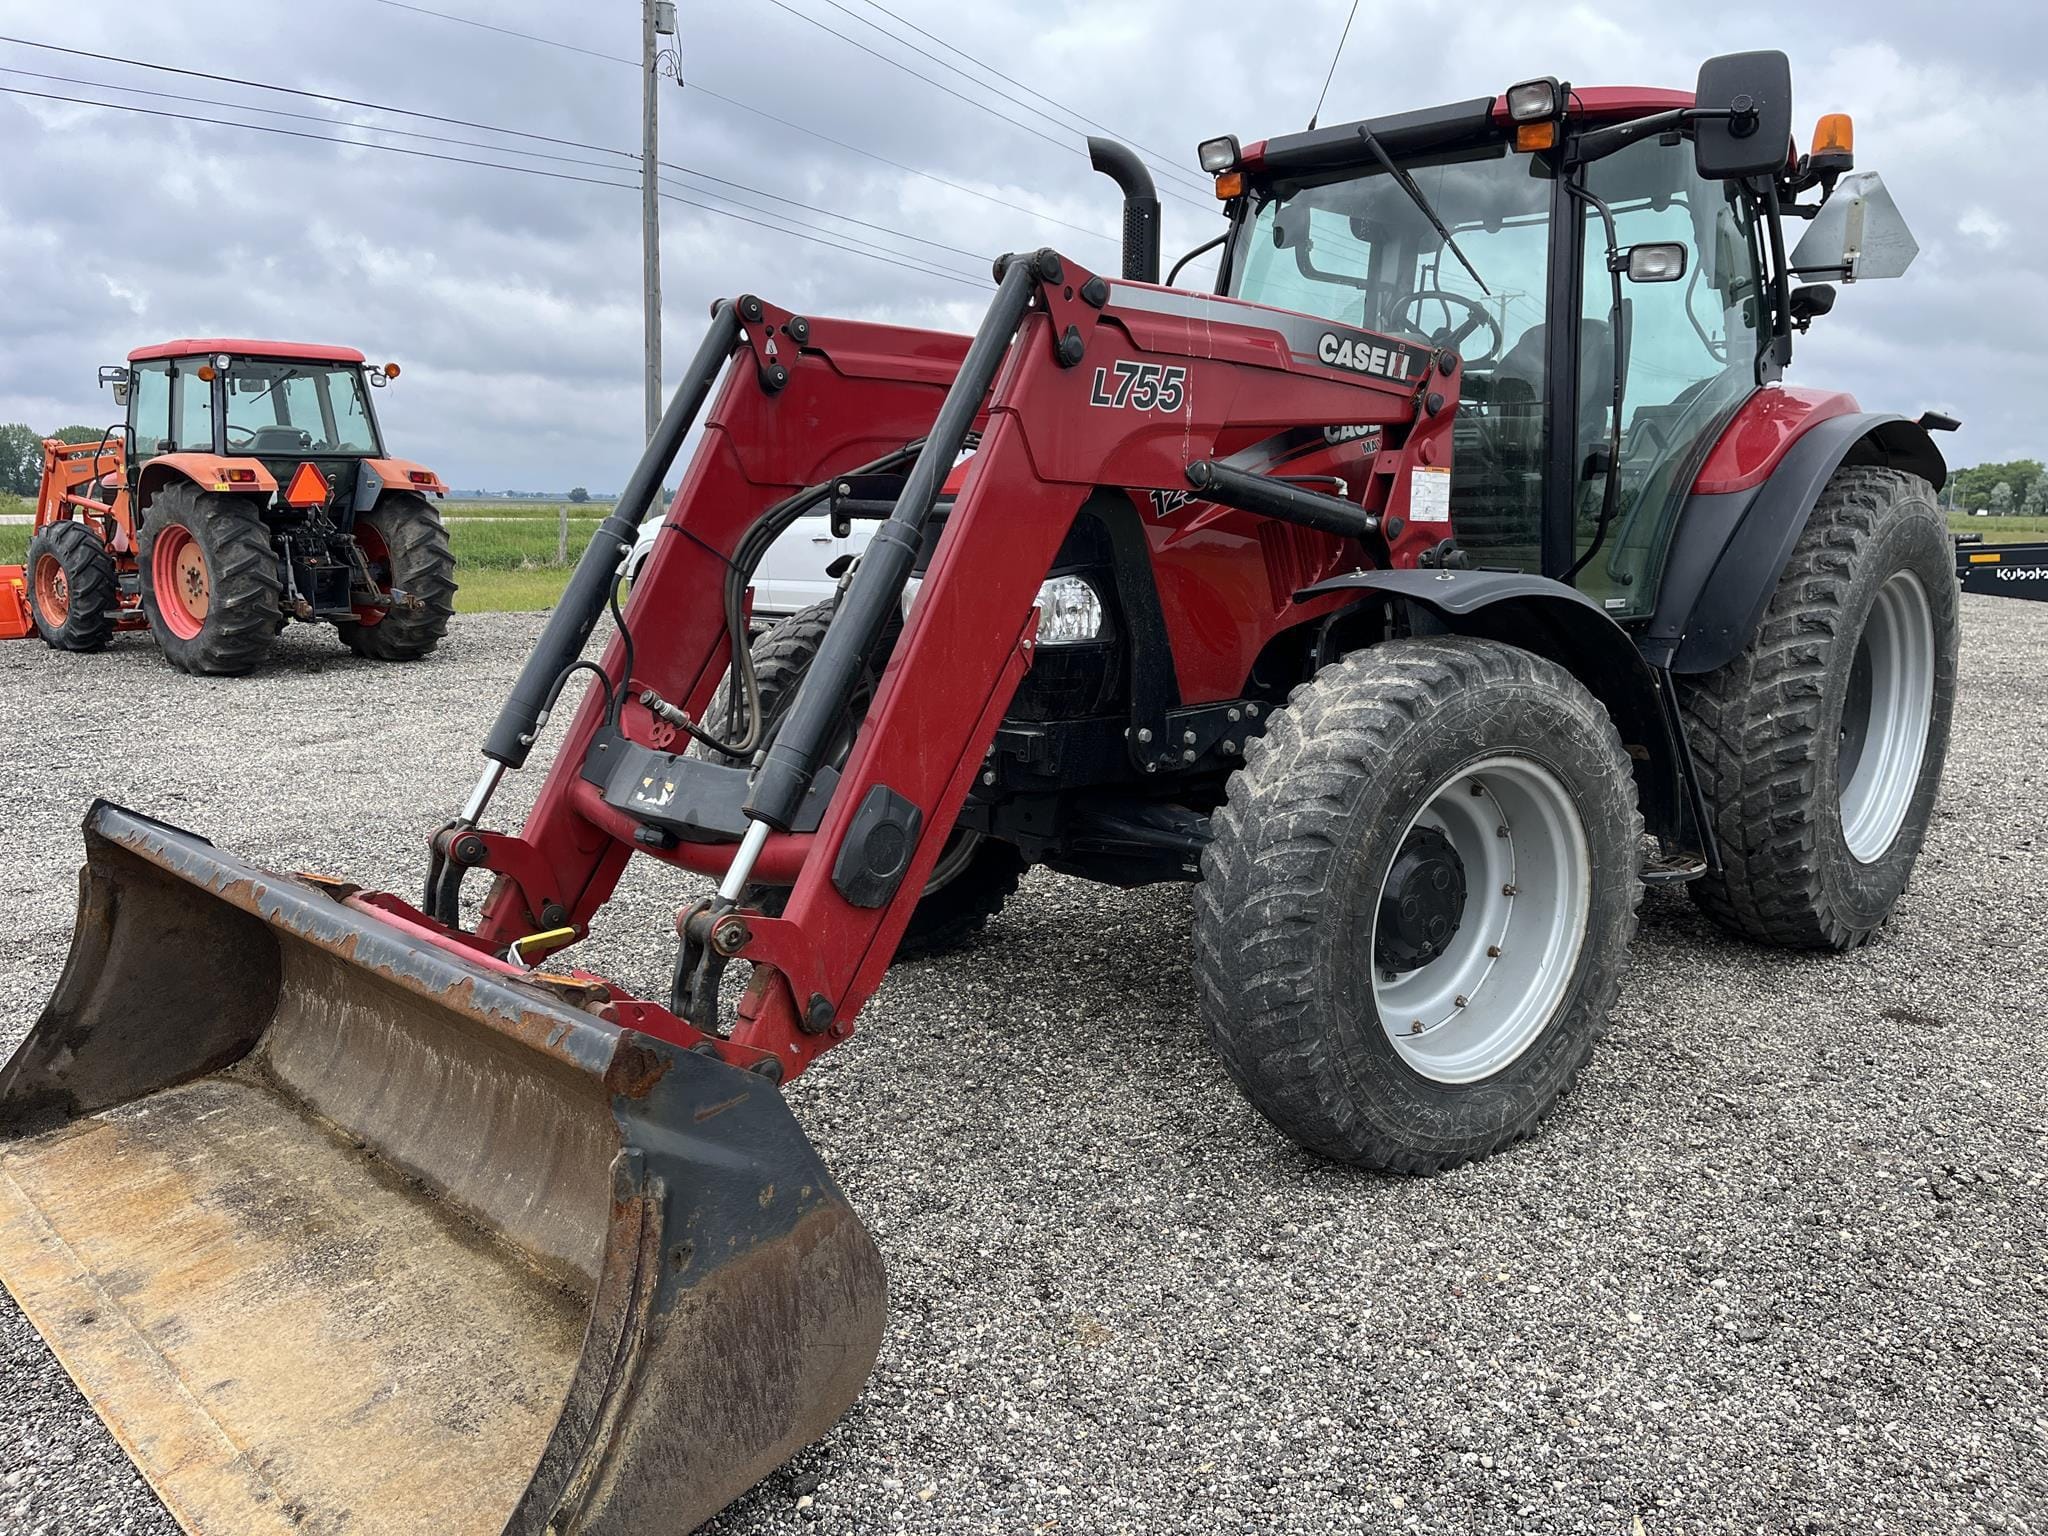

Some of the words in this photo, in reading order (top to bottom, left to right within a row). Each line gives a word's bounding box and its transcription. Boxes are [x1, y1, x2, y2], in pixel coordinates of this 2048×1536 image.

[1318, 333, 1388, 375] CASE
[1089, 359, 1187, 413] L755
[1323, 424, 1381, 444] CA
